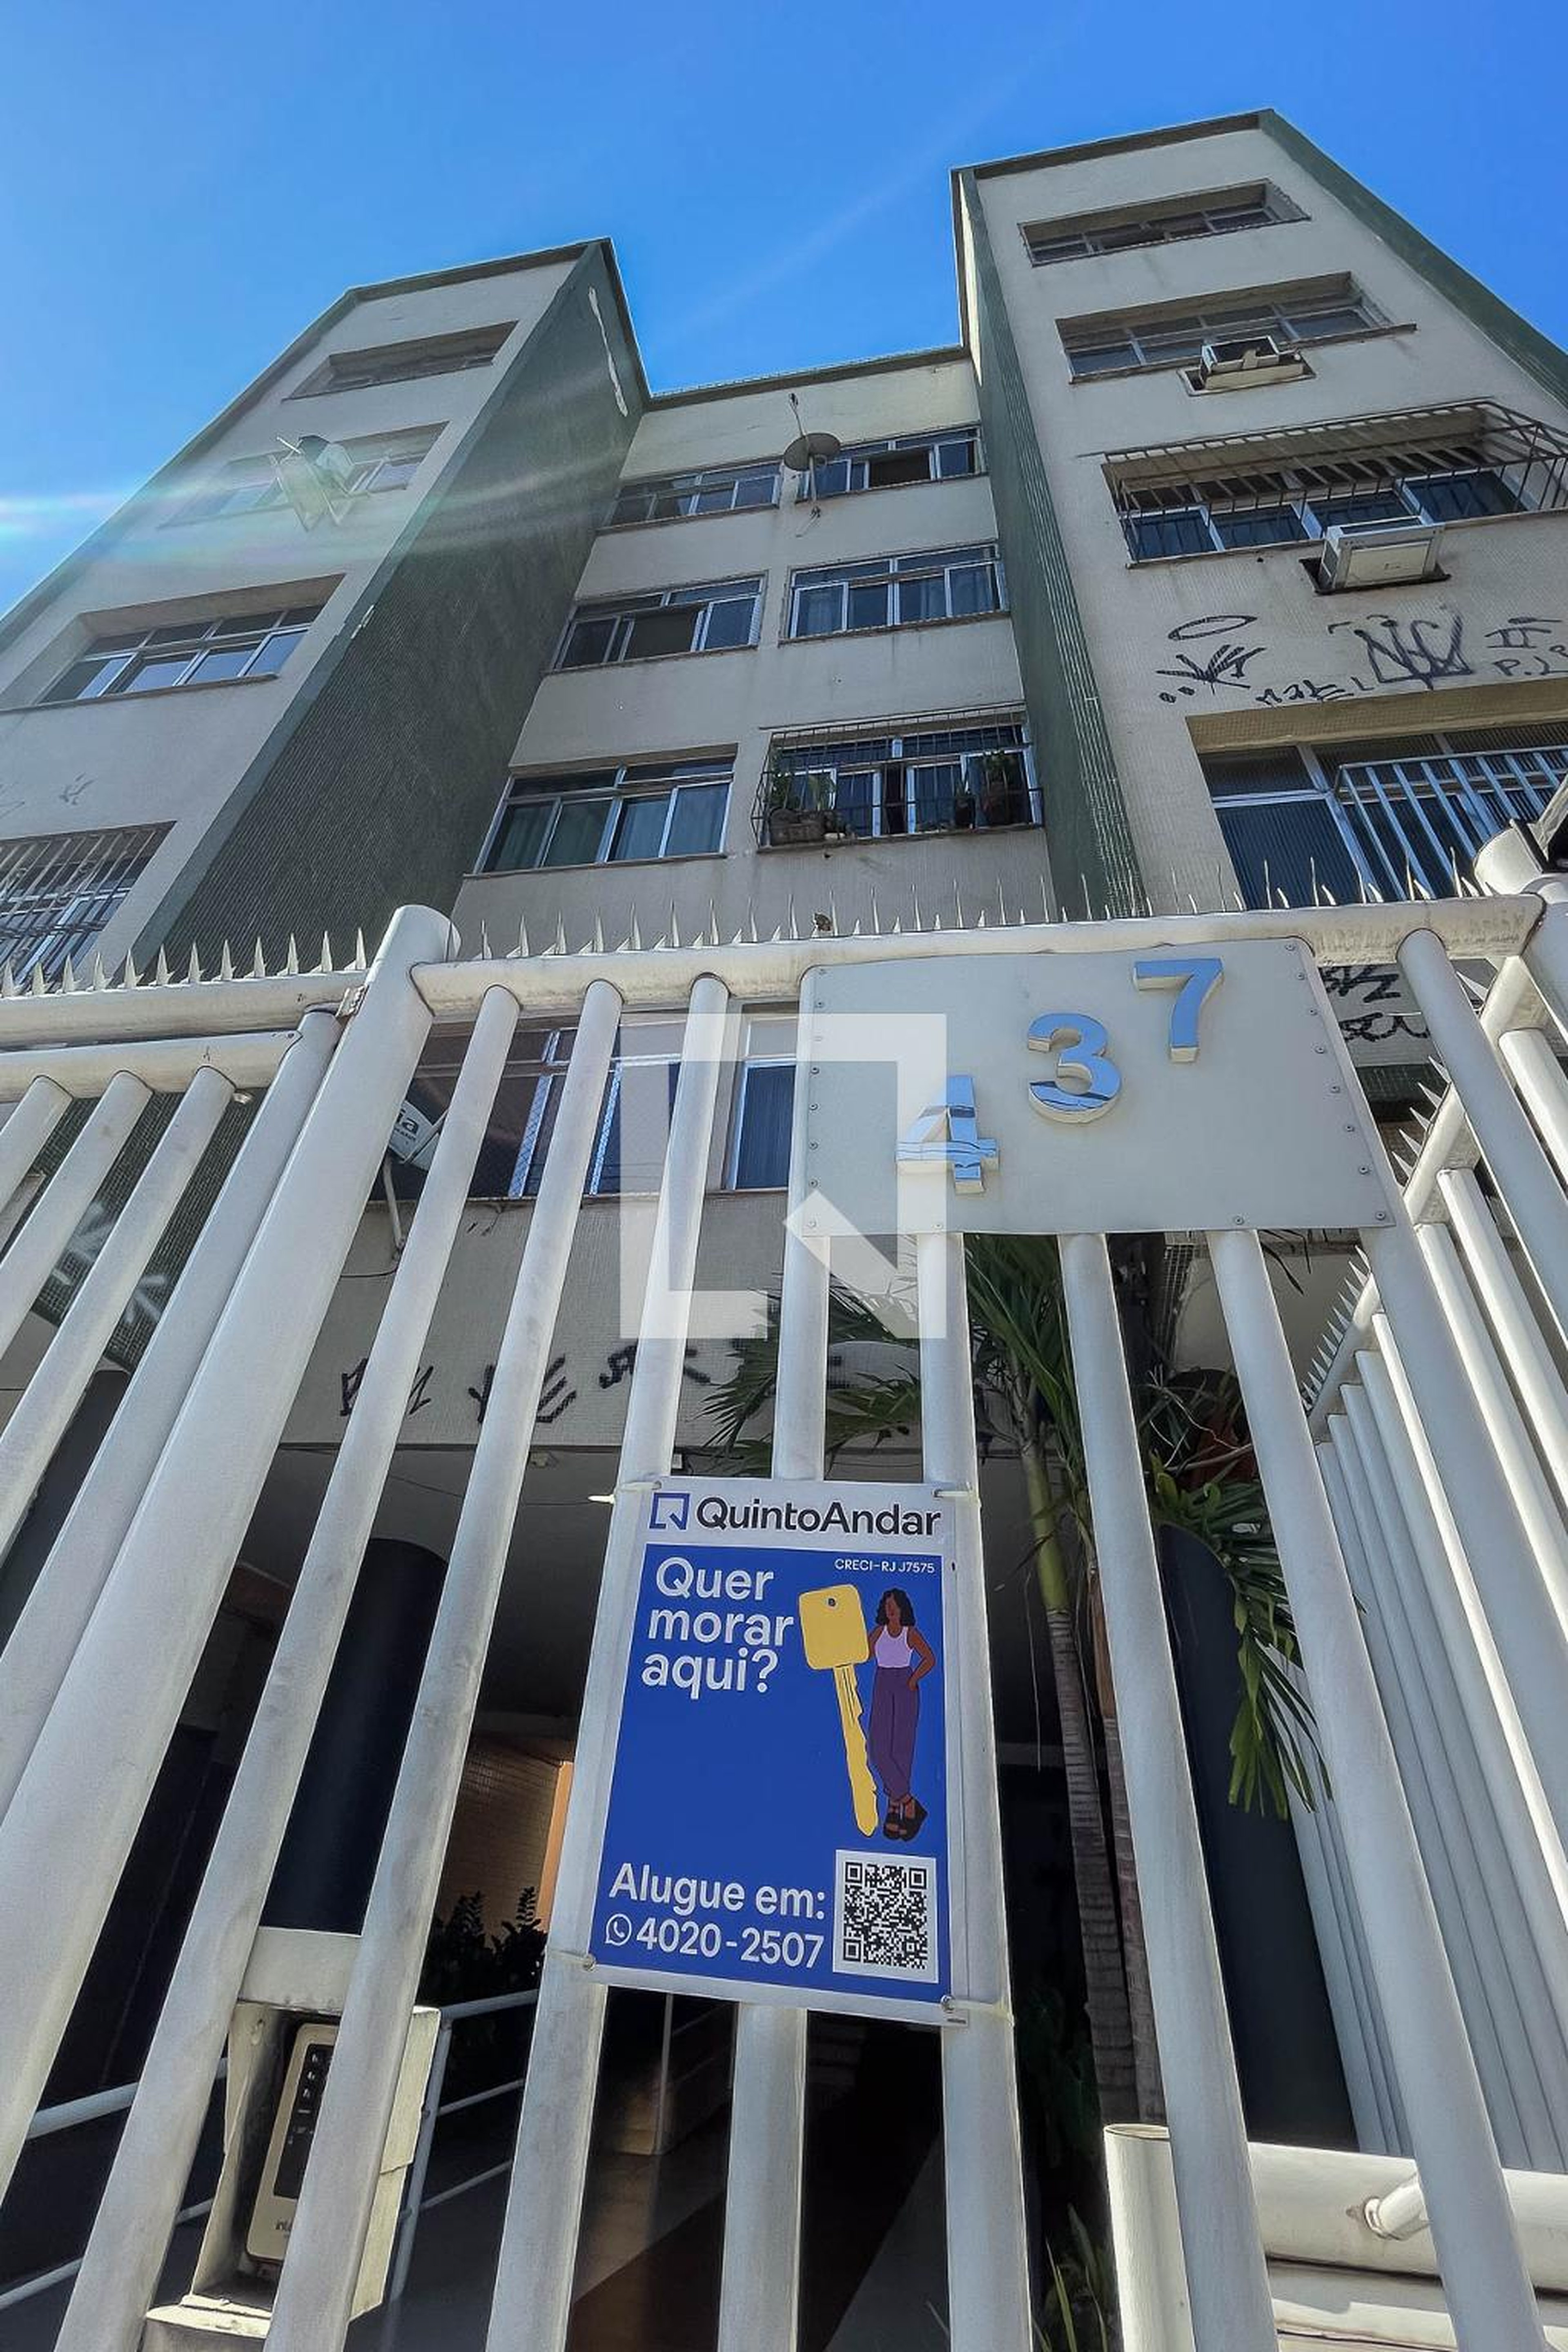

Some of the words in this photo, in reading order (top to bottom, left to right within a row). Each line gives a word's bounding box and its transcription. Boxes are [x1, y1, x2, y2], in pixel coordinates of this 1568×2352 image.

[895, 957, 1224, 1195] 437
[697, 1497, 941, 1536] QuintoAndar
[656, 1557, 774, 1600] Quer
[834, 1559, 895, 1572] CRECI-RJ
[898, 1562, 934, 1573] J7575
[648, 1608, 794, 1646] morar
[641, 1648, 778, 1700] aqui?
[609, 1862, 745, 1916] Alugue
[755, 1884, 825, 1920] em:
[636, 1918, 825, 1969] 4020-2507
